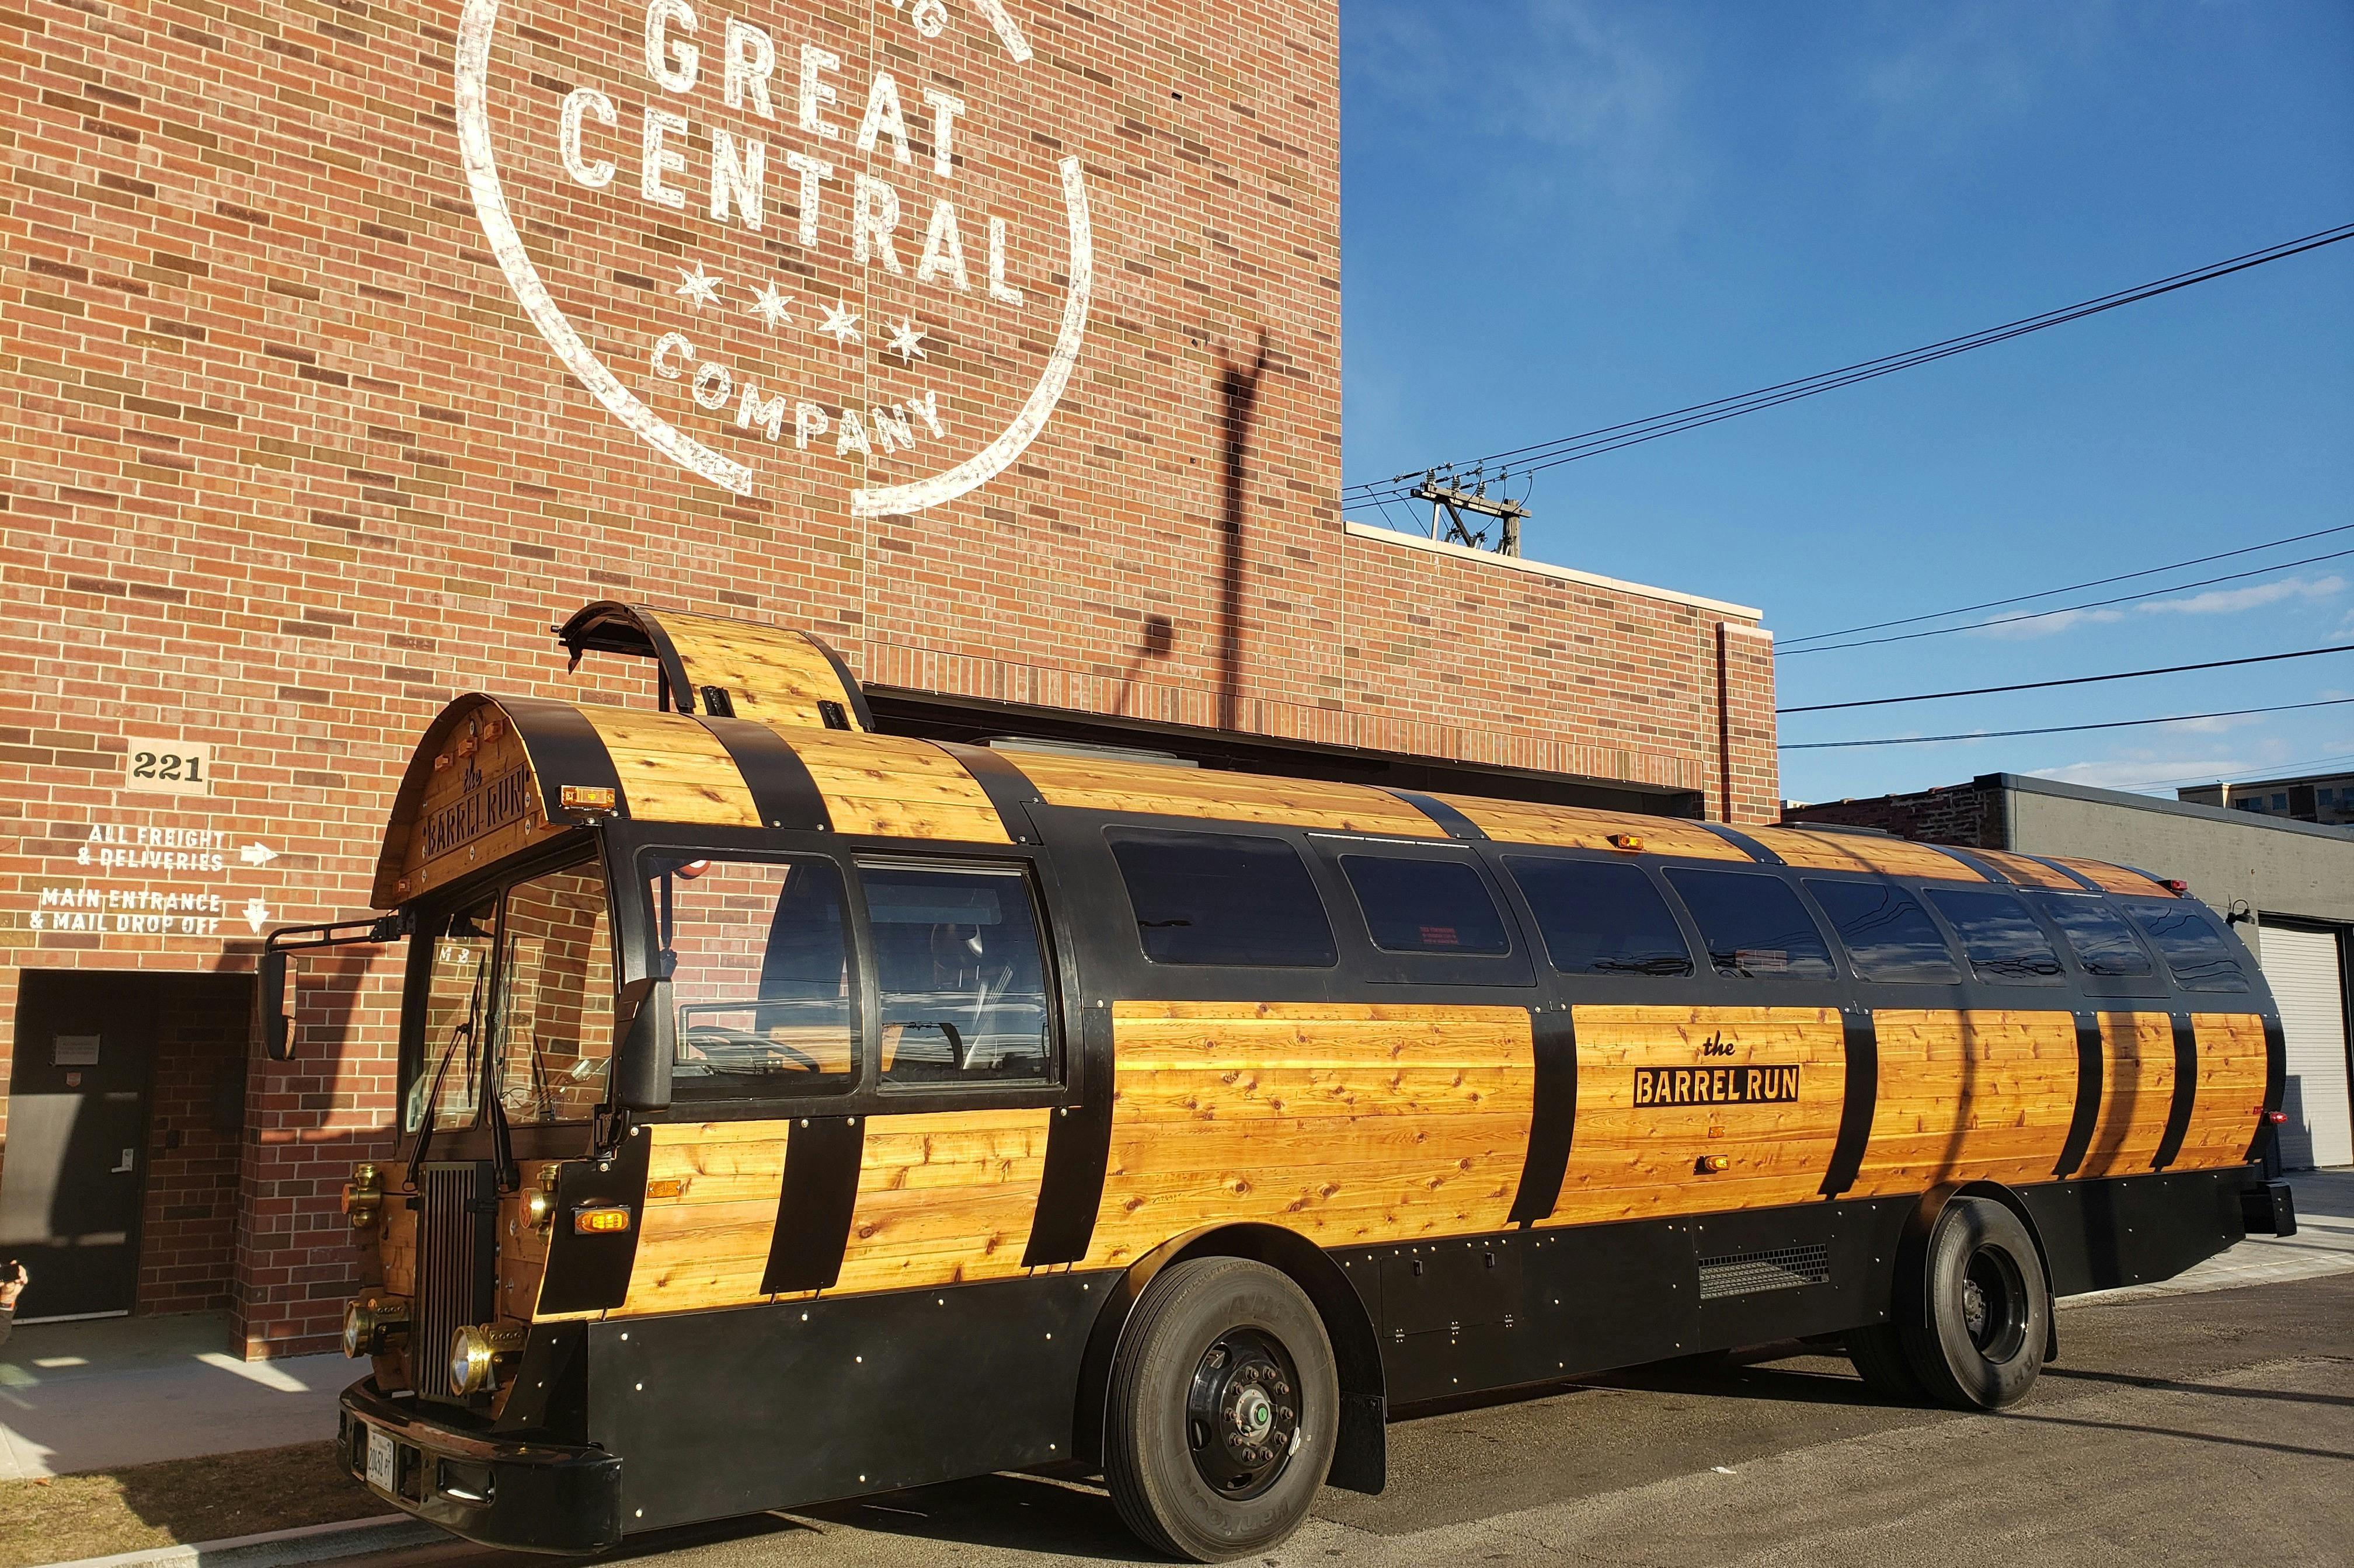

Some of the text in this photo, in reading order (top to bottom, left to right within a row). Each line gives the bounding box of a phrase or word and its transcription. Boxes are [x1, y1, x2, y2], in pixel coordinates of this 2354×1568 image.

[645, 0, 966, 177] GREAT
[559, 88, 1023, 306] CENTRAL
[652, 332, 945, 456] COMPANY
[133, 751, 203, 783] 221
[463, 755, 482, 793] the
[427, 769, 521, 857] BARREL RUN
[88, 824, 225, 849] ALL FREIGHT
[77, 846, 223, 872] & DELIVERIES
[41, 887, 220, 912] MAIN ENTRANCE
[29, 911, 219, 935] & MAIL DROP OFF
[1702, 1029, 1736, 1056] the
[1636, 1068, 1798, 1103] BARREL RUN
